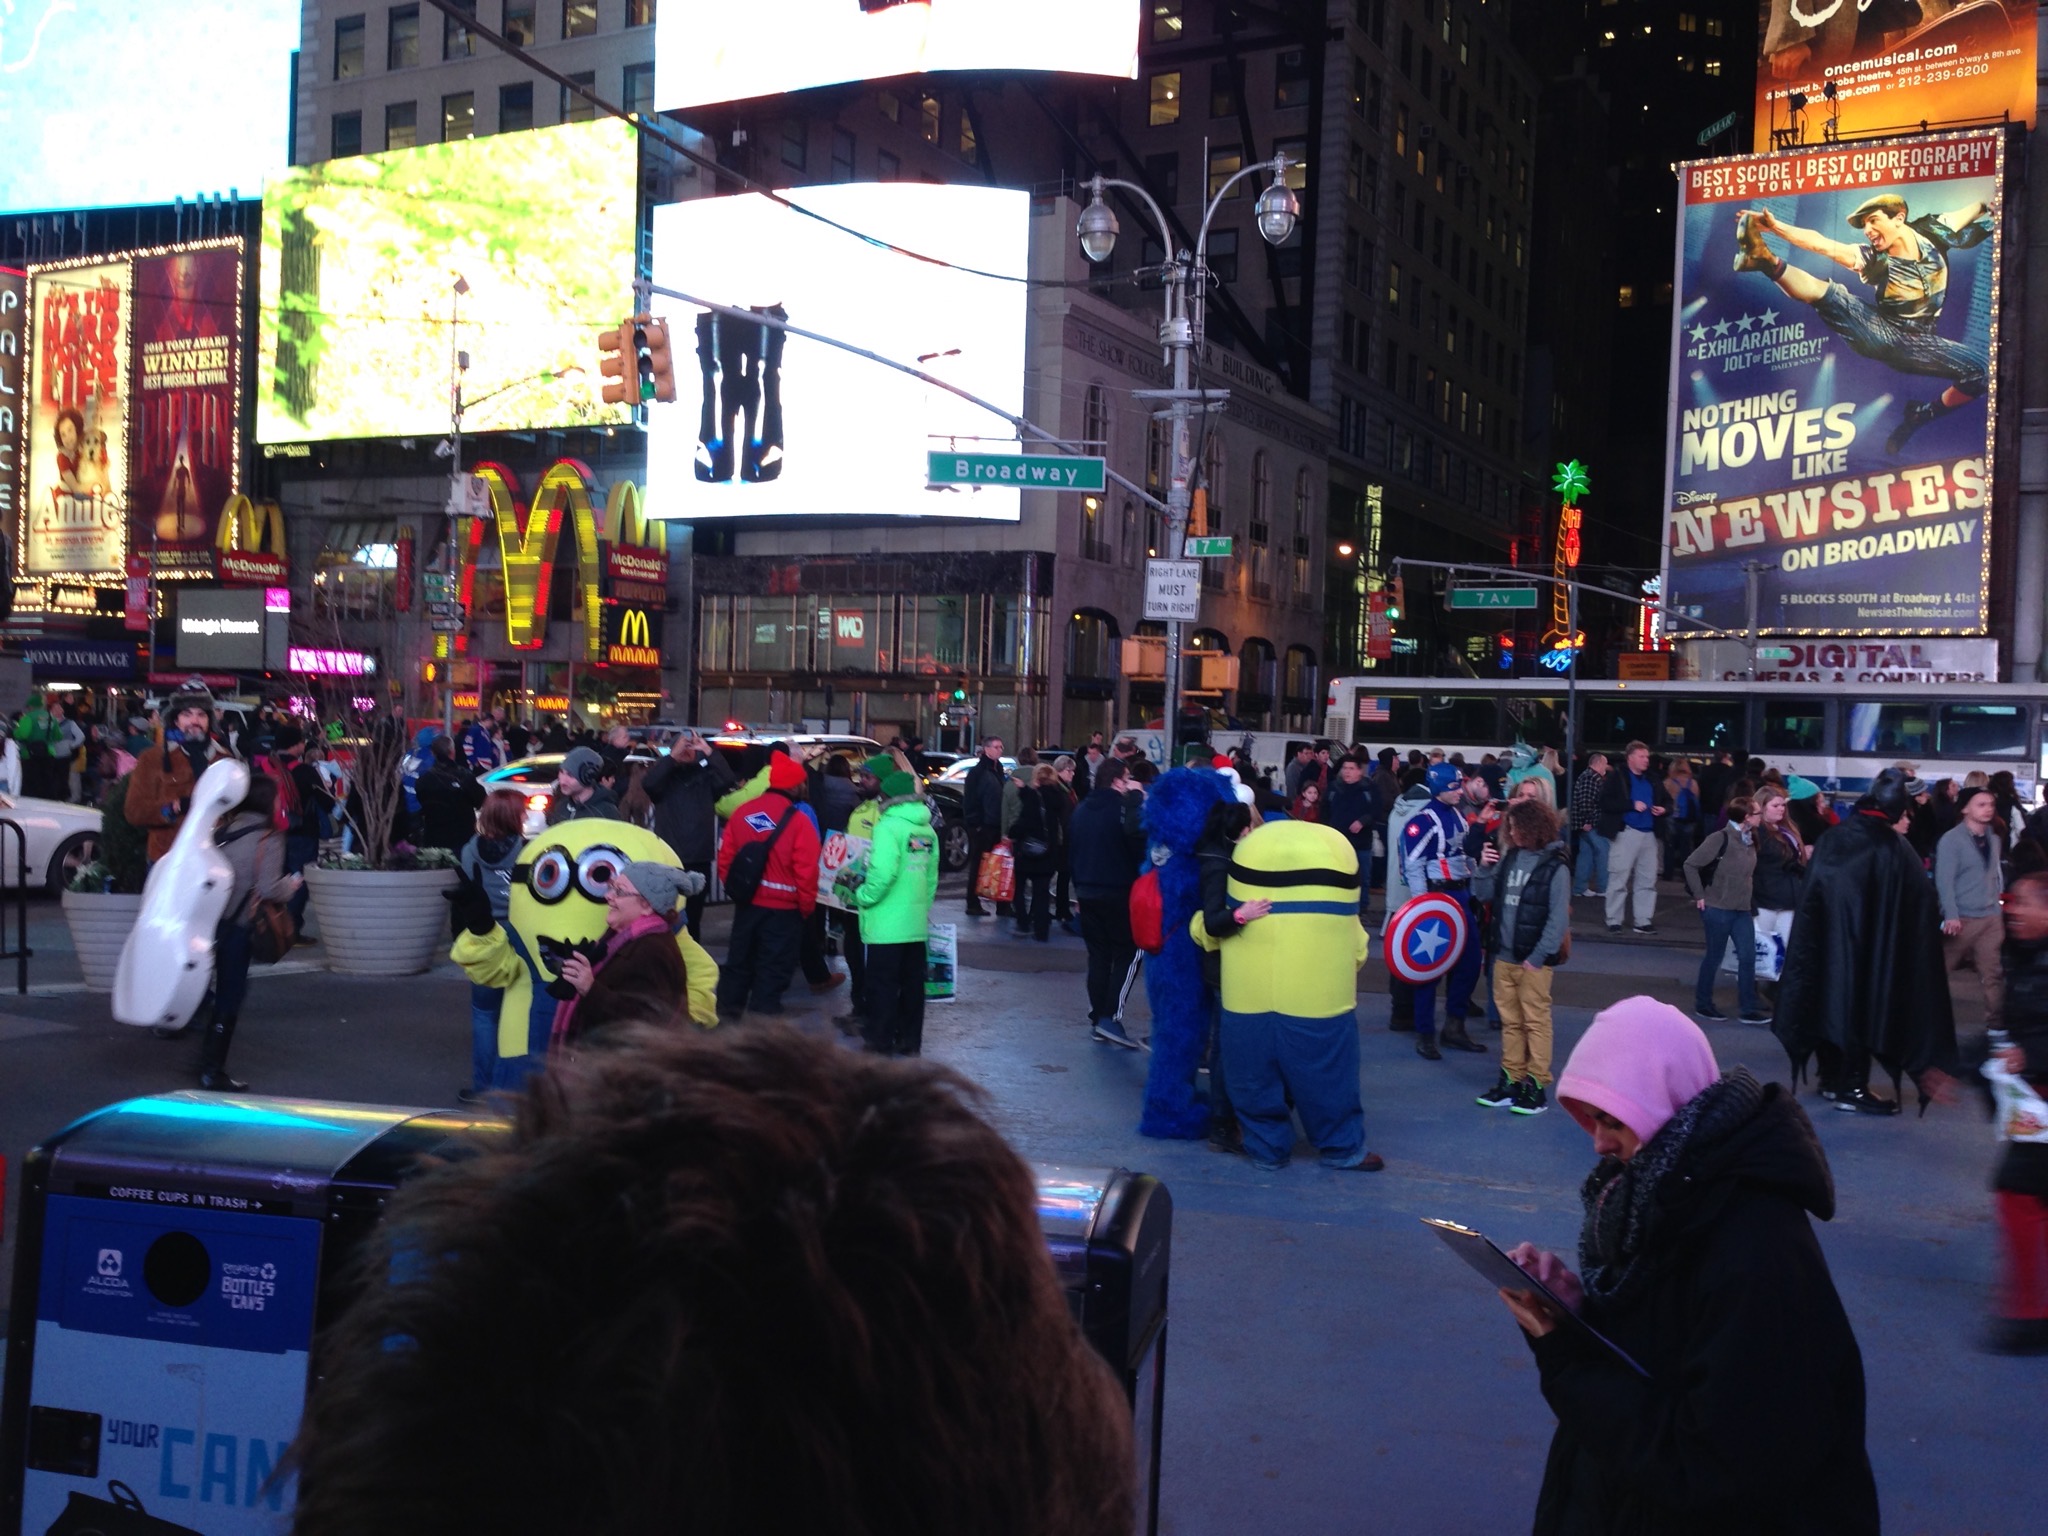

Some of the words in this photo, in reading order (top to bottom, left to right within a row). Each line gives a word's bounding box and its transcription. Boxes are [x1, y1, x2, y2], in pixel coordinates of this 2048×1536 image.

[1824, 42, 1957, 78] oncemusical.com
[1775, 83, 1810, 100] benard
[1824, 76, 1855, 91] jobs
[1857, 69, 1893, 85] theatre,
[1895, 65, 1912, 76] 45th
[1914, 64, 1924, 74] st.
[1925, 58, 1958, 72] between
[1959, 54, 1982, 68] b'way
[1983, 52, 1990, 61] &
[1992, 50, 2004, 59] 8th
[1886, 82, 1895, 91] or
[1898, 63, 1989, 89] 212-239-6200
[1692, 167, 1733, 188] BEST
[1736, 160, 1790, 185] SCORE
[1806, 155, 1848, 177] BEST
[1852, 140, 1993, 173] CHOREOGRAPHY
[1702, 184, 1748, 199] 2012
[1757, 177, 1805, 193] TONY
[1892, 159, 1980, 180] WINNER!
[43, 312, 119, 345] HARD
[1687, 348, 1697, 358] AN
[1698, 322, 1805, 360] EXHILARATING
[165, 339, 192, 352] TONY
[193, 335, 229, 350] AWARD
[1077, 329, 1096, 353] THE
[1098, 338, 1125, 367] SHOW
[142, 348, 229, 374] WINNER!
[1222, 353, 1273, 395] BUILDING
[1723, 352, 1753, 374] JOLT
[1752, 354, 1762, 364] OF
[1771, 362, 1792, 372] DAILY
[41, 368, 118, 406] LIFE
[1683, 388, 1797, 432] NOTHING
[1680, 402, 1857, 477] MOVES
[955, 459, 1078, 486] Broadway
[1792, 448, 1848, 481] LIKE
[1671, 457, 1986, 558] NEWSIES
[1202, 540, 1210, 554] 7
[1781, 549, 1820, 573] ON
[1823, 519, 1978, 567] BROADWAY
[222, 557, 288, 577] McDonald's
[611, 552, 667, 573] McDonald's
[1149, 567, 1173, 578] RIGHT
[1176, 568, 1198, 579] LANE
[1158, 584, 1186, 597] MUST
[1476, 593, 1485, 604] 7
[1490, 594, 1511, 605] Av
[1780, 594, 1788, 605] 5
[1790, 593, 1836, 605] BLOCKS
[1837, 592, 1877, 604] SOUTH
[1880, 593, 1890, 603] at
[1892, 592, 1942, 607] Broadway
[1944, 592, 1952, 604] &
[1954, 592, 1976, 604] 41st
[1147, 601, 1168, 613] TURN
[1170, 602, 1195, 614] RIGHT
[1857, 605, 1975, 619] NewsiesTheMusical.com
[66, 651, 129, 667] EXCHANGE
[1778, 644, 1932, 670] DIGITAL
[1833, 671, 1845, 683] &
[1858, 670, 1986, 683] COMPUTERS
[110, 1186, 154, 1201] COFFEE
[158, 1190, 189, 1204] CUPS
[193, 1193, 205, 1206] IN
[209, 1195, 248, 1209] TRASH
[87, 1275, 130, 1289] ALCOA
[222, 1276, 275, 1297] BOTTLES
[231, 1294, 265, 1311] CANS
[107, 1418, 160, 1449] YOUR
